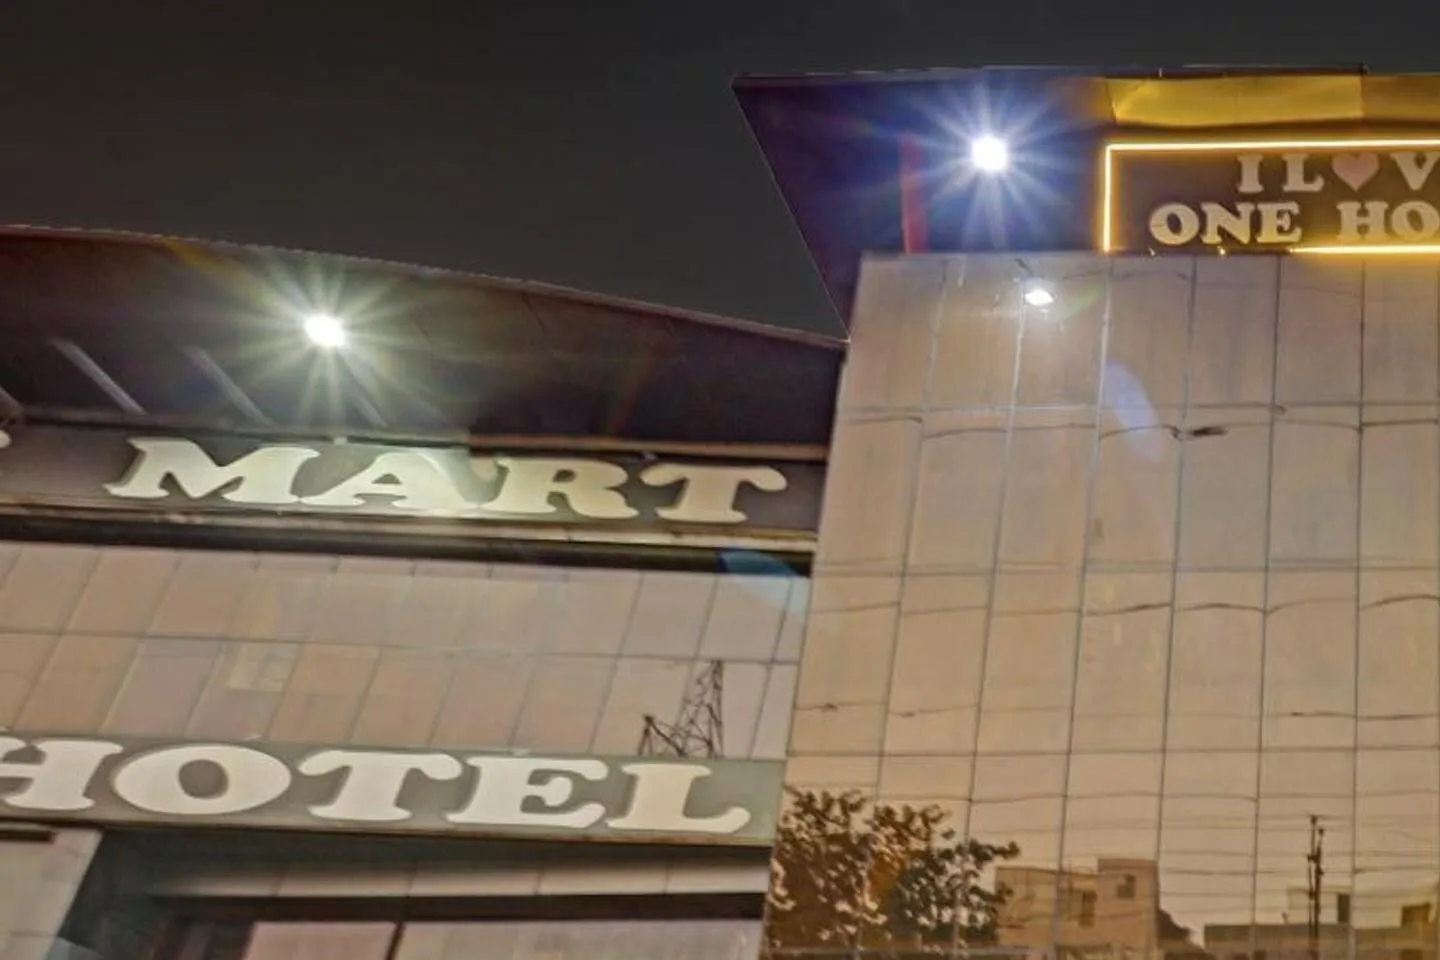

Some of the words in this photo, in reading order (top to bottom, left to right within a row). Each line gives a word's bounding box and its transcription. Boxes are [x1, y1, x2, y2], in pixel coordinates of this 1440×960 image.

[1236, 153, 1264, 194] I
[1148, 200, 1302, 247] ONE
[105, 436, 788, 524] MART
[0, 735, 751, 834] HOTEL
